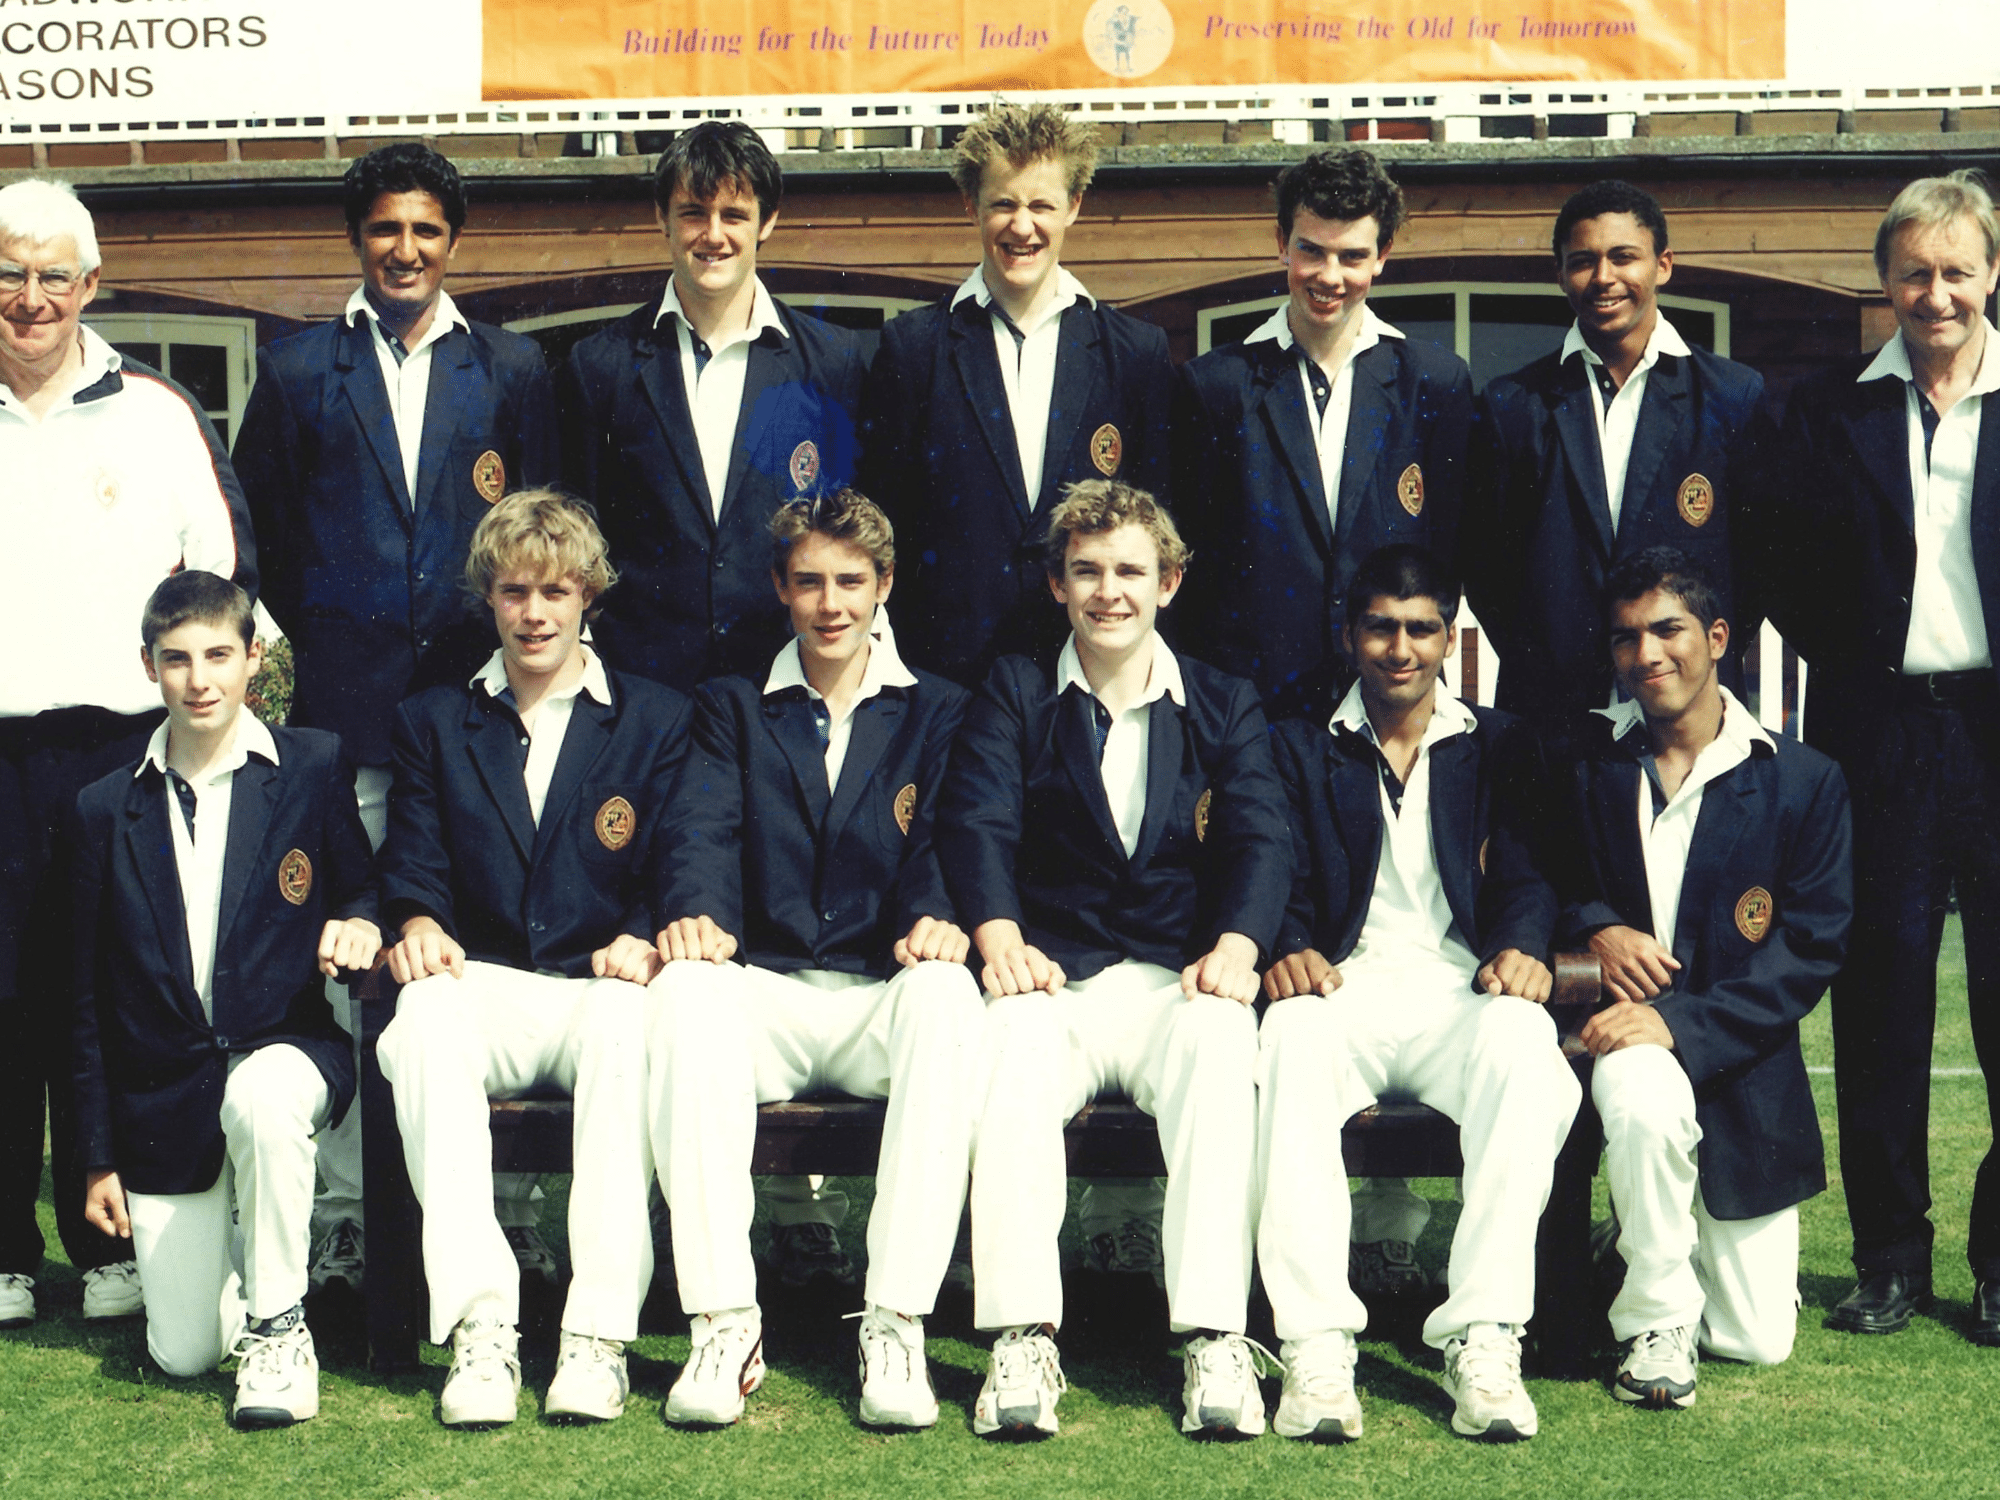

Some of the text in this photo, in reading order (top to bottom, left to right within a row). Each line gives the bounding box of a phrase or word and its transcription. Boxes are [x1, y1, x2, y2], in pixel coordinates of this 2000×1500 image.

[1, 16, 267, 54] CORATORS
[623, 23, 1050, 58] Building for the Future Today
[1205, 14, 1636, 44] Preserving the Old for Tomorrow
